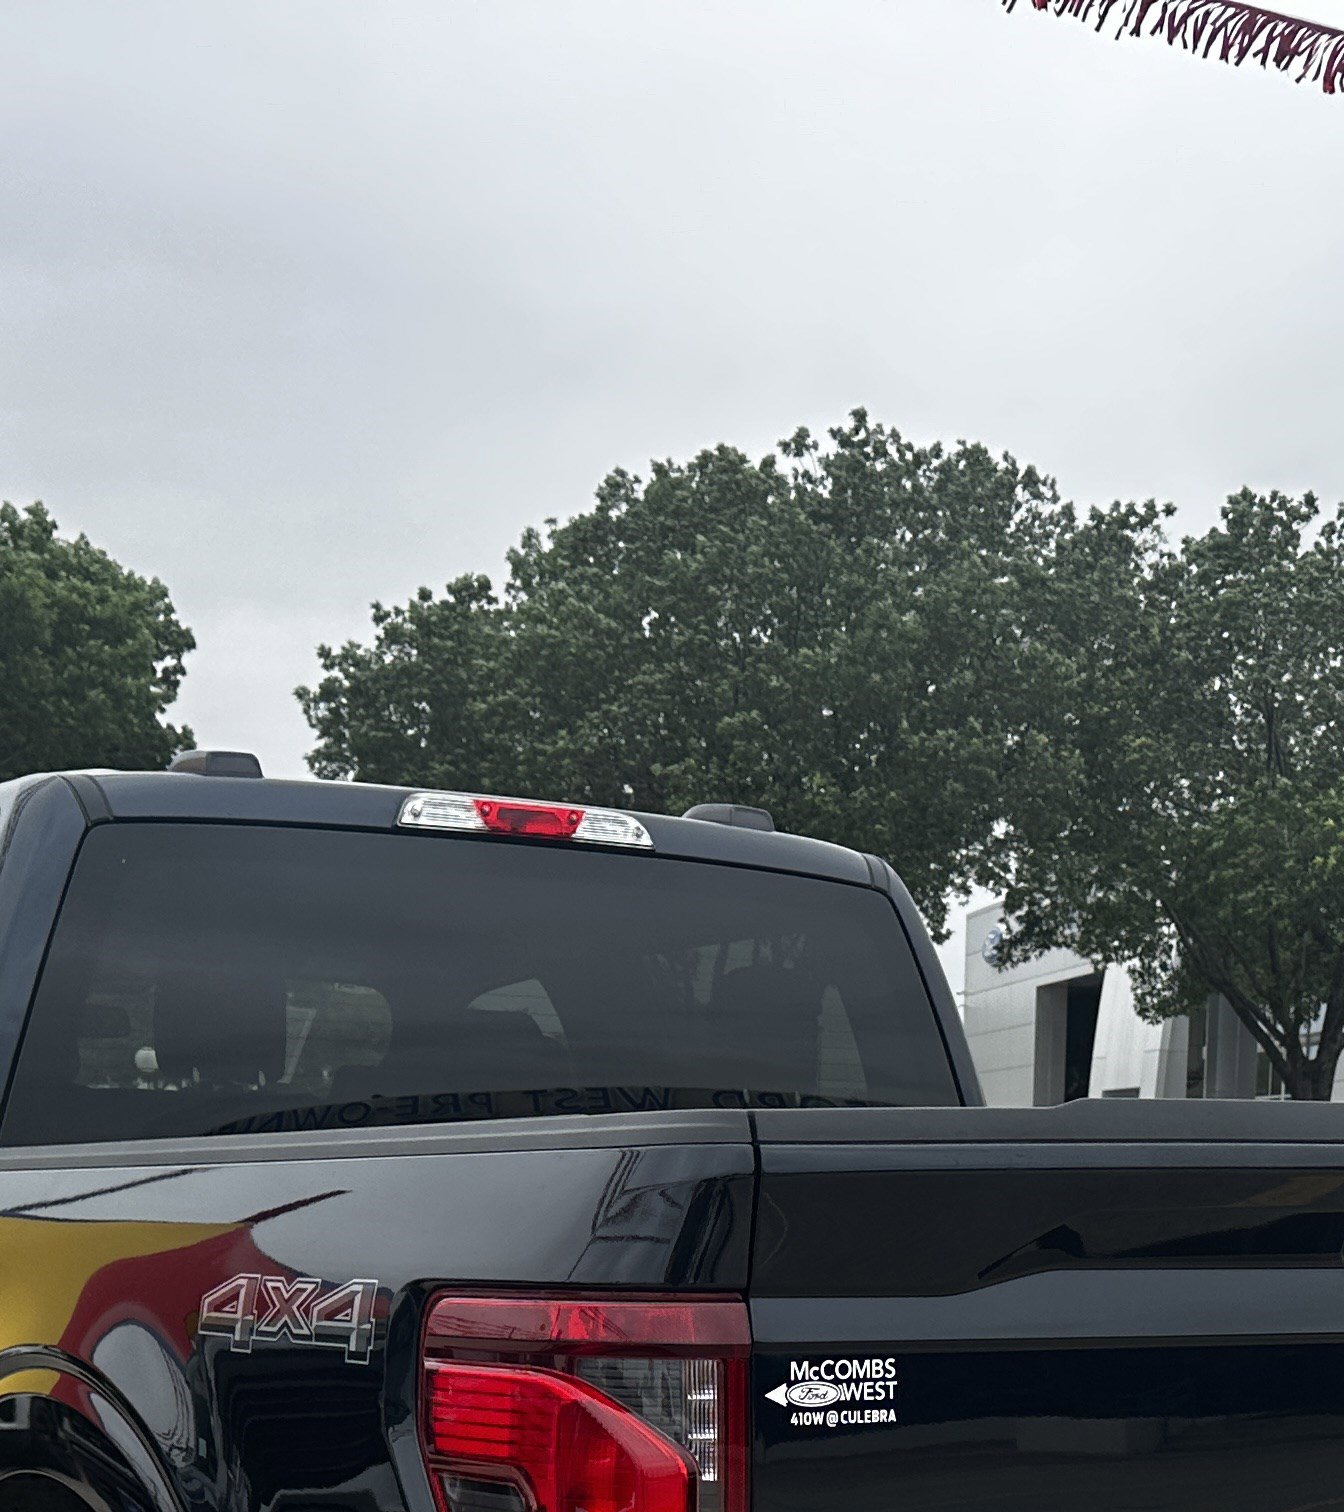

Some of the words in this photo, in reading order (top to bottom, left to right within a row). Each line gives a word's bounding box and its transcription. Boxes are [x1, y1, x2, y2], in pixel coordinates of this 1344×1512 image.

[790, 1358, 896, 1381] McCOMBS
[842, 1381, 898, 1401] WEST
[840, 1409, 897, 1424] CULEBRA
